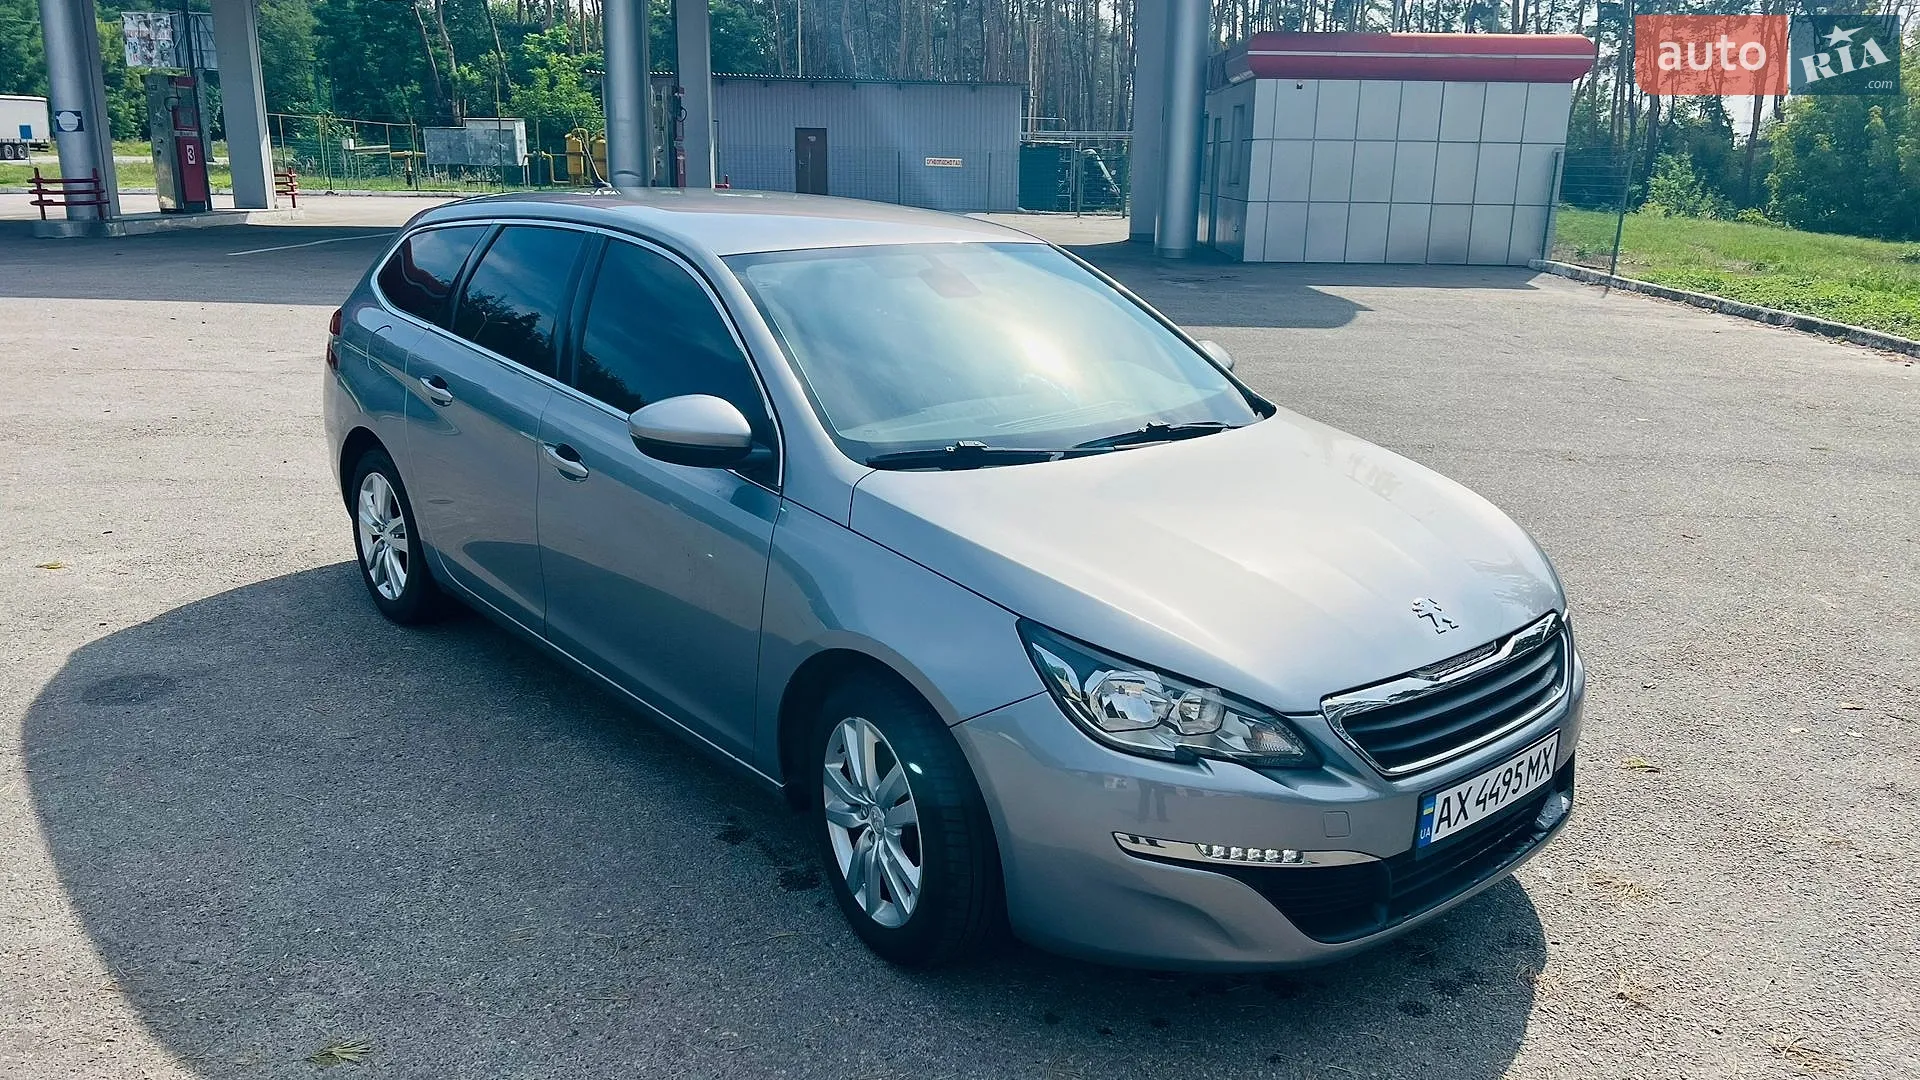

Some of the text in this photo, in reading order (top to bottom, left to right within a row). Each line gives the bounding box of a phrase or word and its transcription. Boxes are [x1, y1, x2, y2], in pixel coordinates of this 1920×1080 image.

[188, 148, 194, 161] 3
[1435, 742, 1554, 834] AX 4495 MX
[1419, 828, 1431, 840] UA
